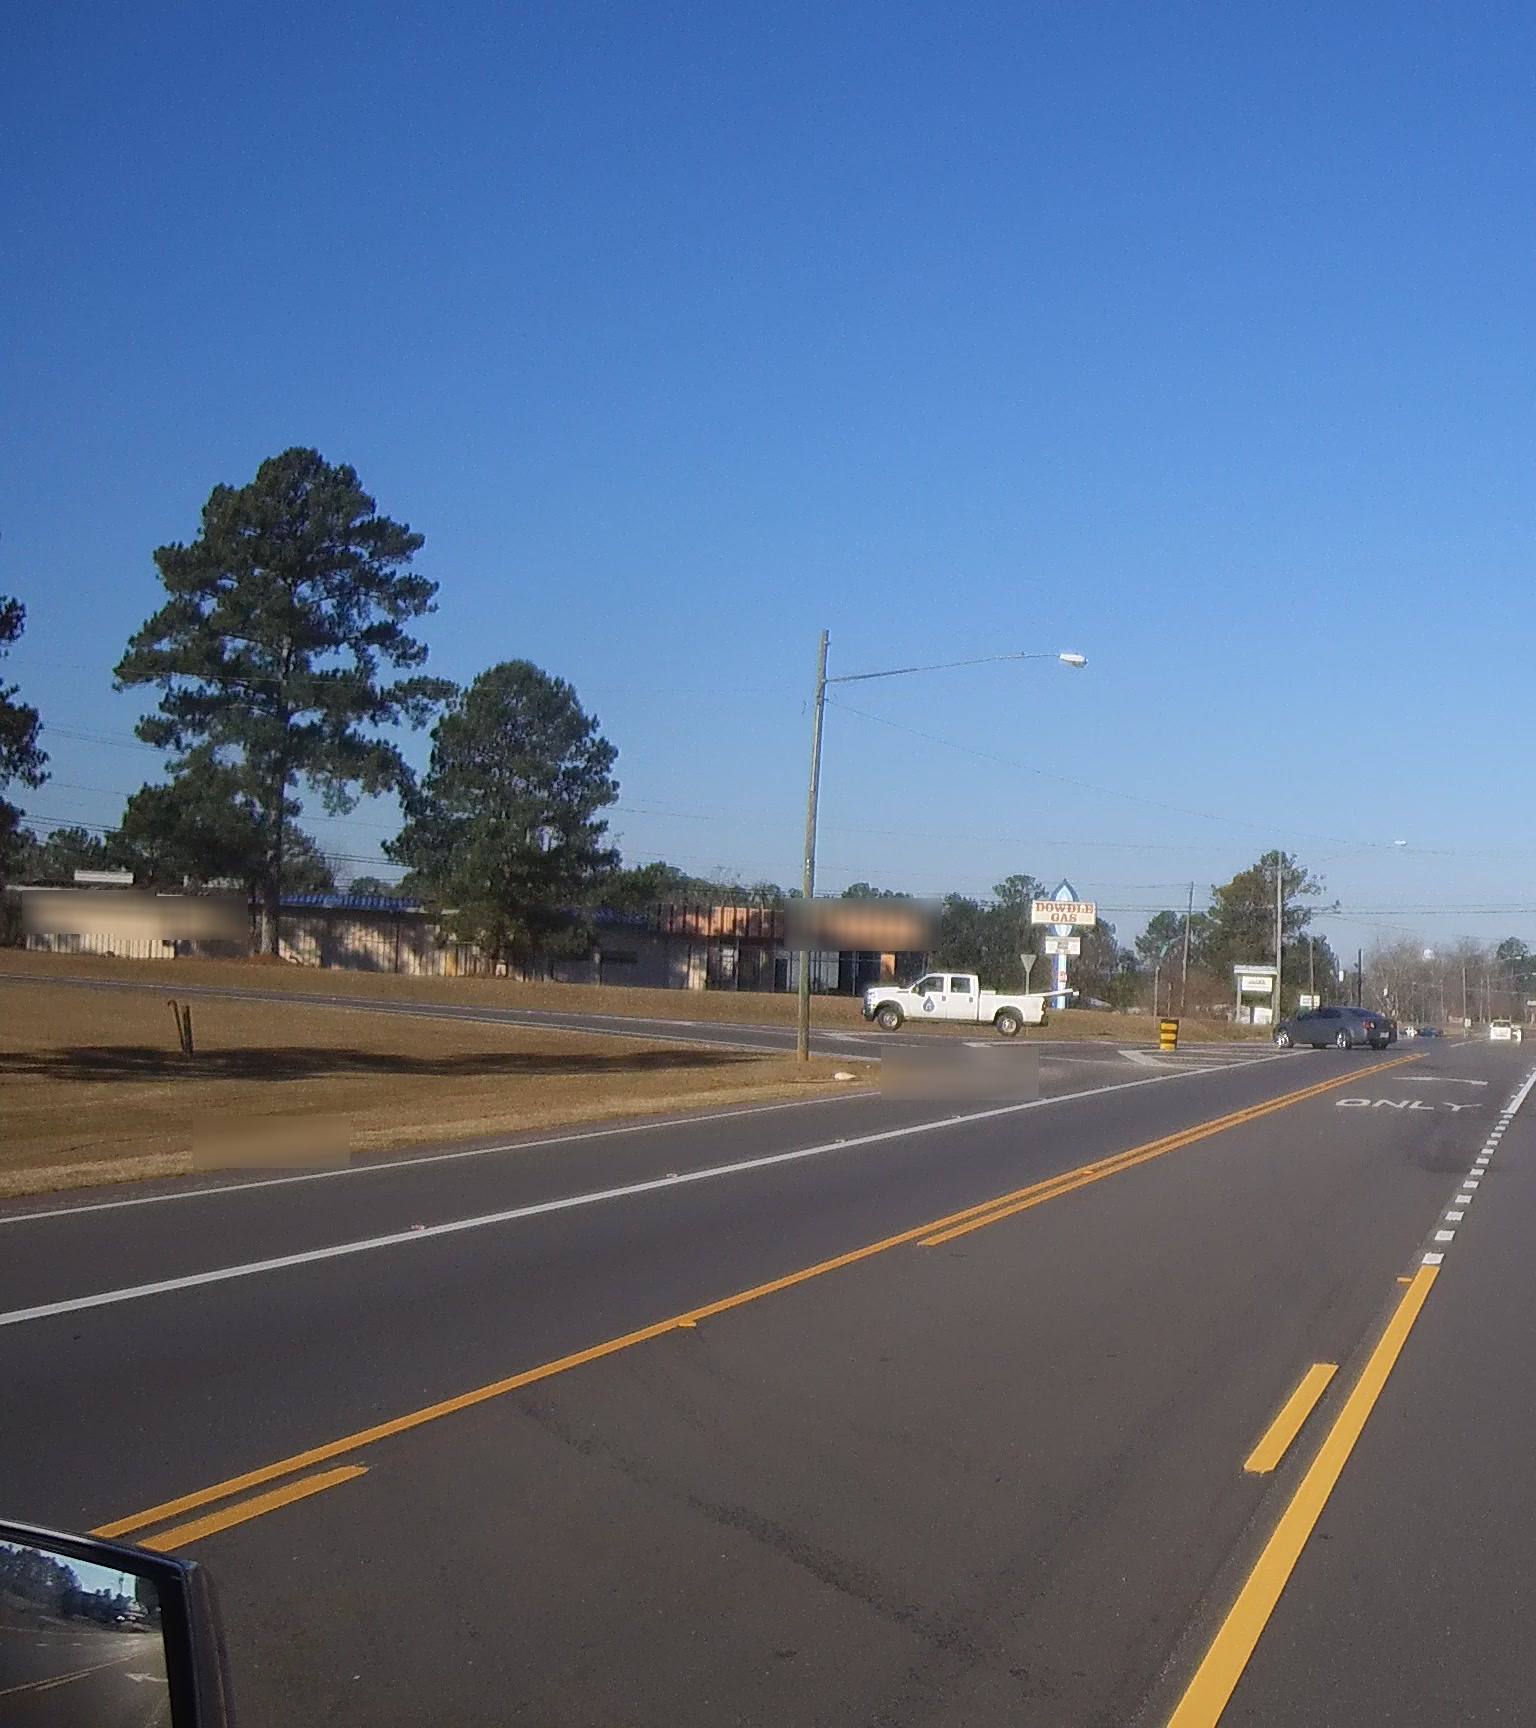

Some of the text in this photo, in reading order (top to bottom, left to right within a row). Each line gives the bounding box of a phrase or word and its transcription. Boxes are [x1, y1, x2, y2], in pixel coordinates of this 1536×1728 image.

[1036, 902, 1094, 913] DOWDLE
[1050, 912, 1078, 922] GAS
[1334, 1098, 1483, 1111] ONLY
